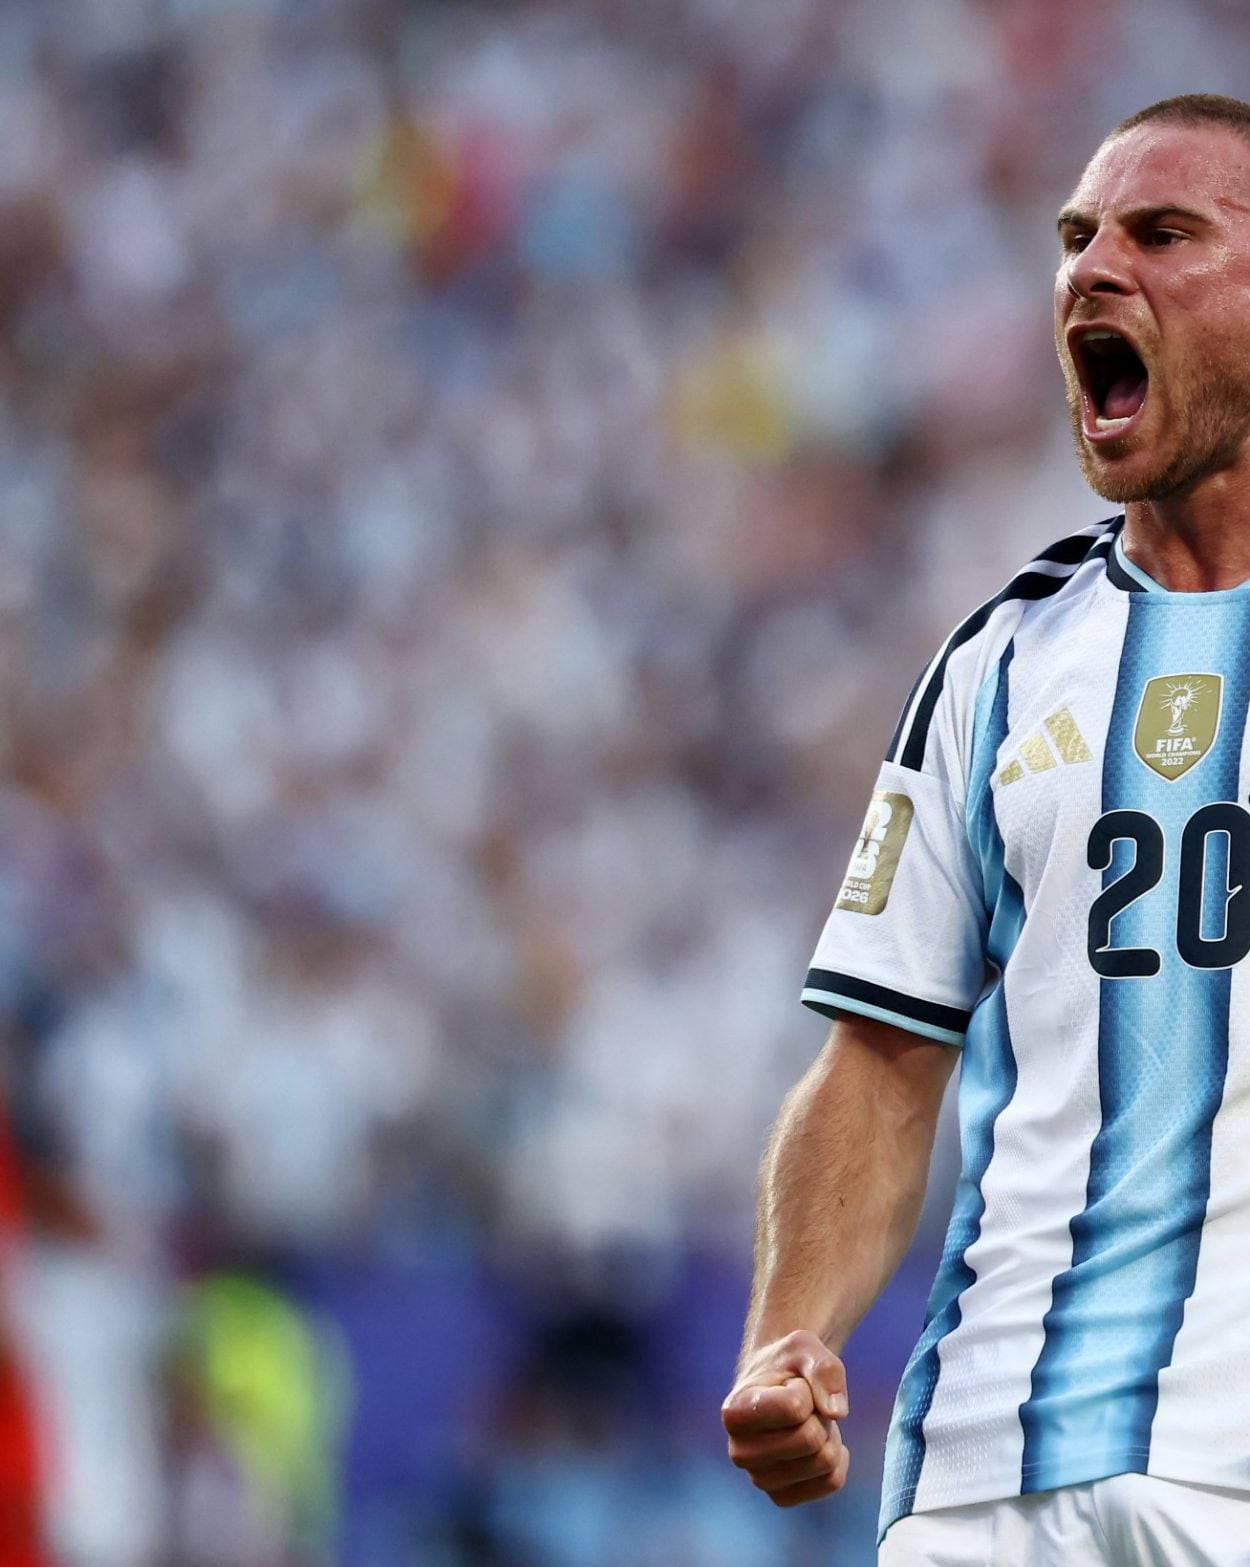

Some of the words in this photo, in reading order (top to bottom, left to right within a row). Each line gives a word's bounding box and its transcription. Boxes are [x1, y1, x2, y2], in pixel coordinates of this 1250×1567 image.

[1156, 737, 1194, 752] FIFA
[1160, 757, 1184, 766] 2022
[842, 888, 869, 903] 026
